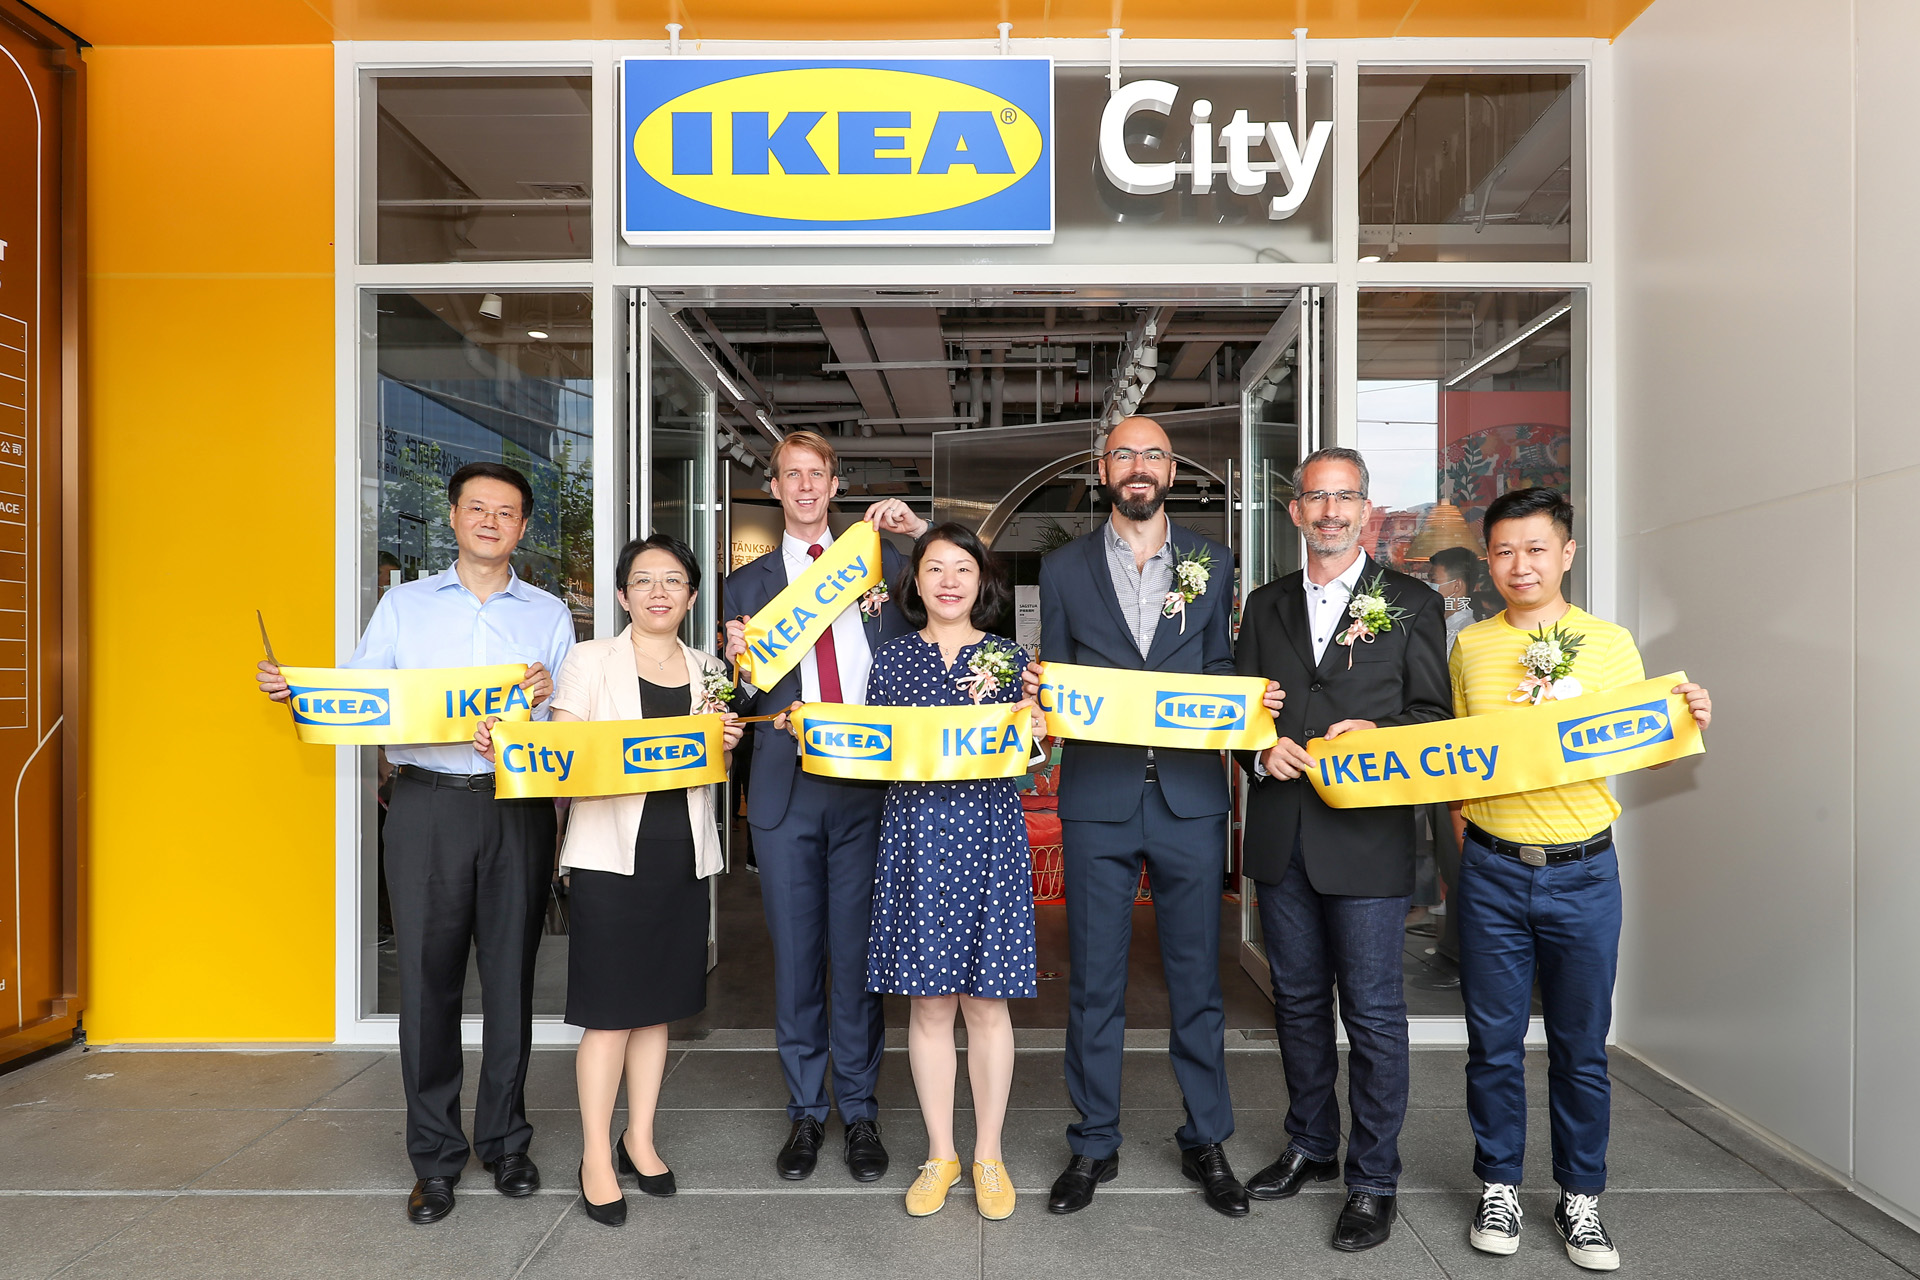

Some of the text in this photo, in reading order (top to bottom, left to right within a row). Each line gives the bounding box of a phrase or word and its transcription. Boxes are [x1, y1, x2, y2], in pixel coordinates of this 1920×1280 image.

[672, 80, 1334, 220] IKEA City
[750, 555, 868, 664] IKEA City
[298, 684, 530, 718] IKEA IKEA
[1037, 683, 1238, 725] City IKEA
[812, 730, 885, 749] IKEA
[942, 725, 1024, 756] IKEA
[1319, 714, 1662, 786] IKEA City IKEA
[502, 743, 700, 782] City IKEA
